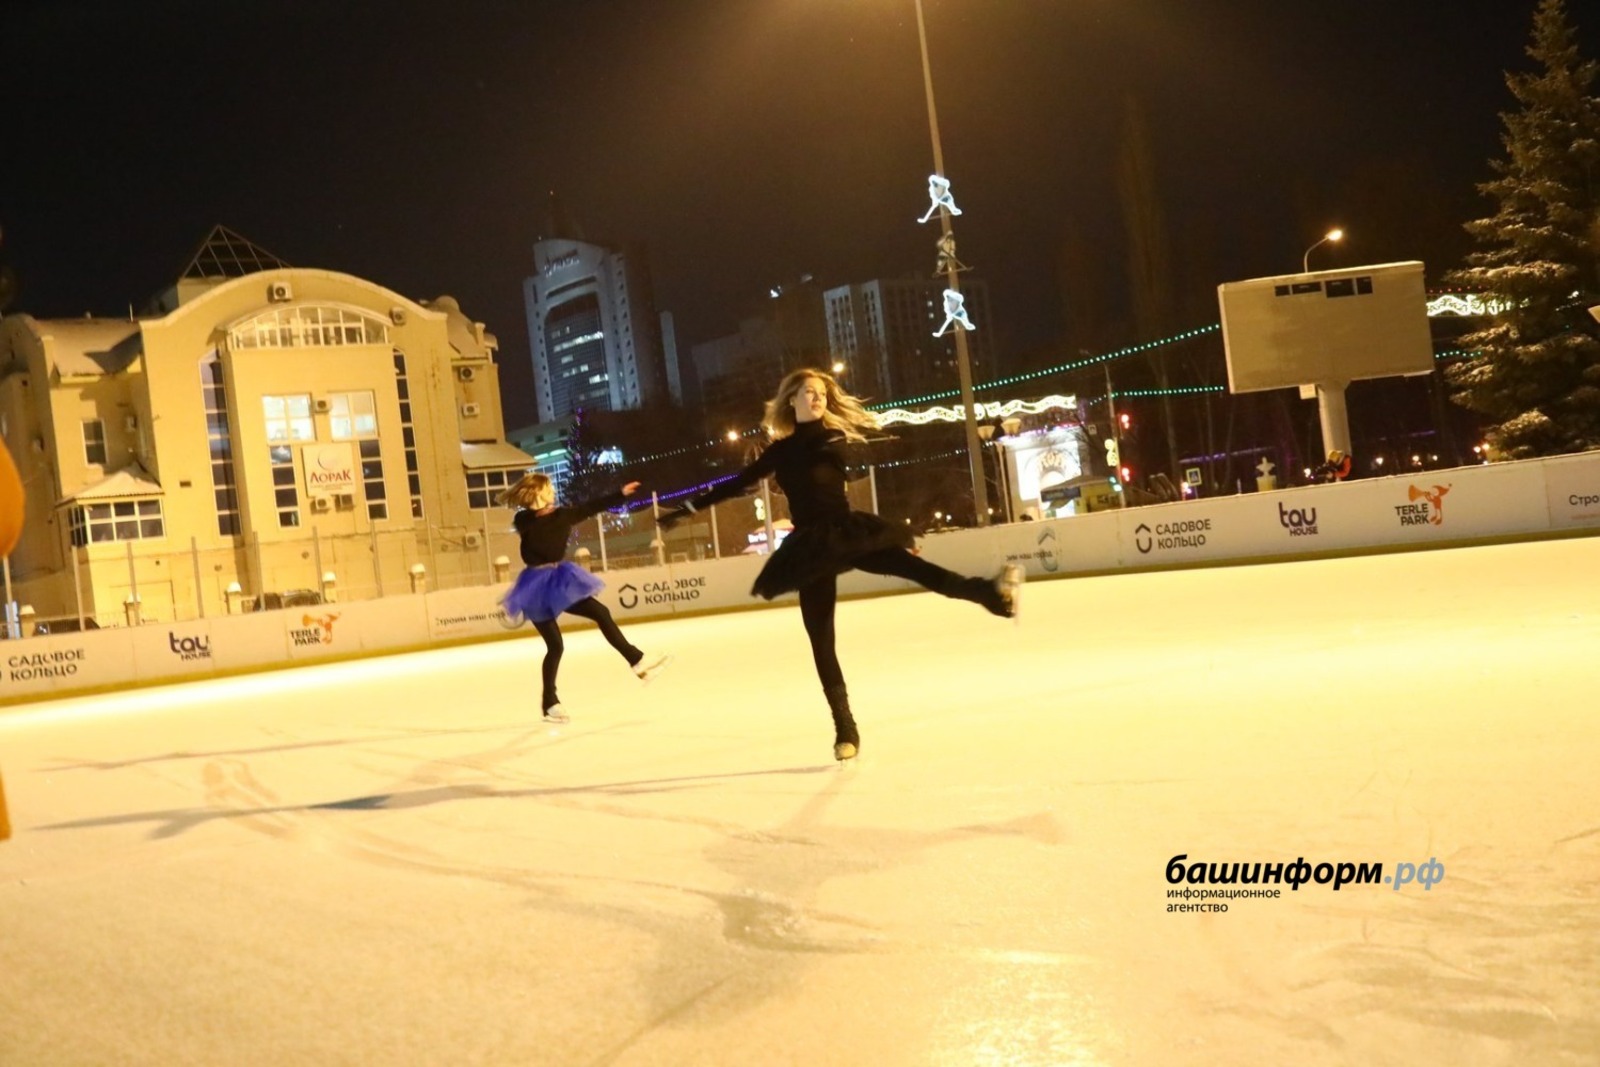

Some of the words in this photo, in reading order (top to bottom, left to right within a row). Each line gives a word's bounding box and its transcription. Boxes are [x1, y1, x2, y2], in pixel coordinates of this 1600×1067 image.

[1278, 501, 1317, 528] tau
[1395, 502, 1429, 516] TERLE
[1155, 518, 1212, 535] САДОВОЕ
[1400, 513, 1430, 526] PARK
[1290, 525, 1319, 537] HOUSE
[1158, 533, 1207, 550] КОЛЬЦО
[645, 589, 701, 605] КОЛЬЦО
[468, 612, 487, 622] наш
[290, 627, 321, 639] TERLE
[294, 635, 321, 647] PARK
[8, 648, 86, 668] САДОВОЕ
[180, 651, 212, 662] HOUSE
[10, 663, 78, 682] КОЛЬЦО
